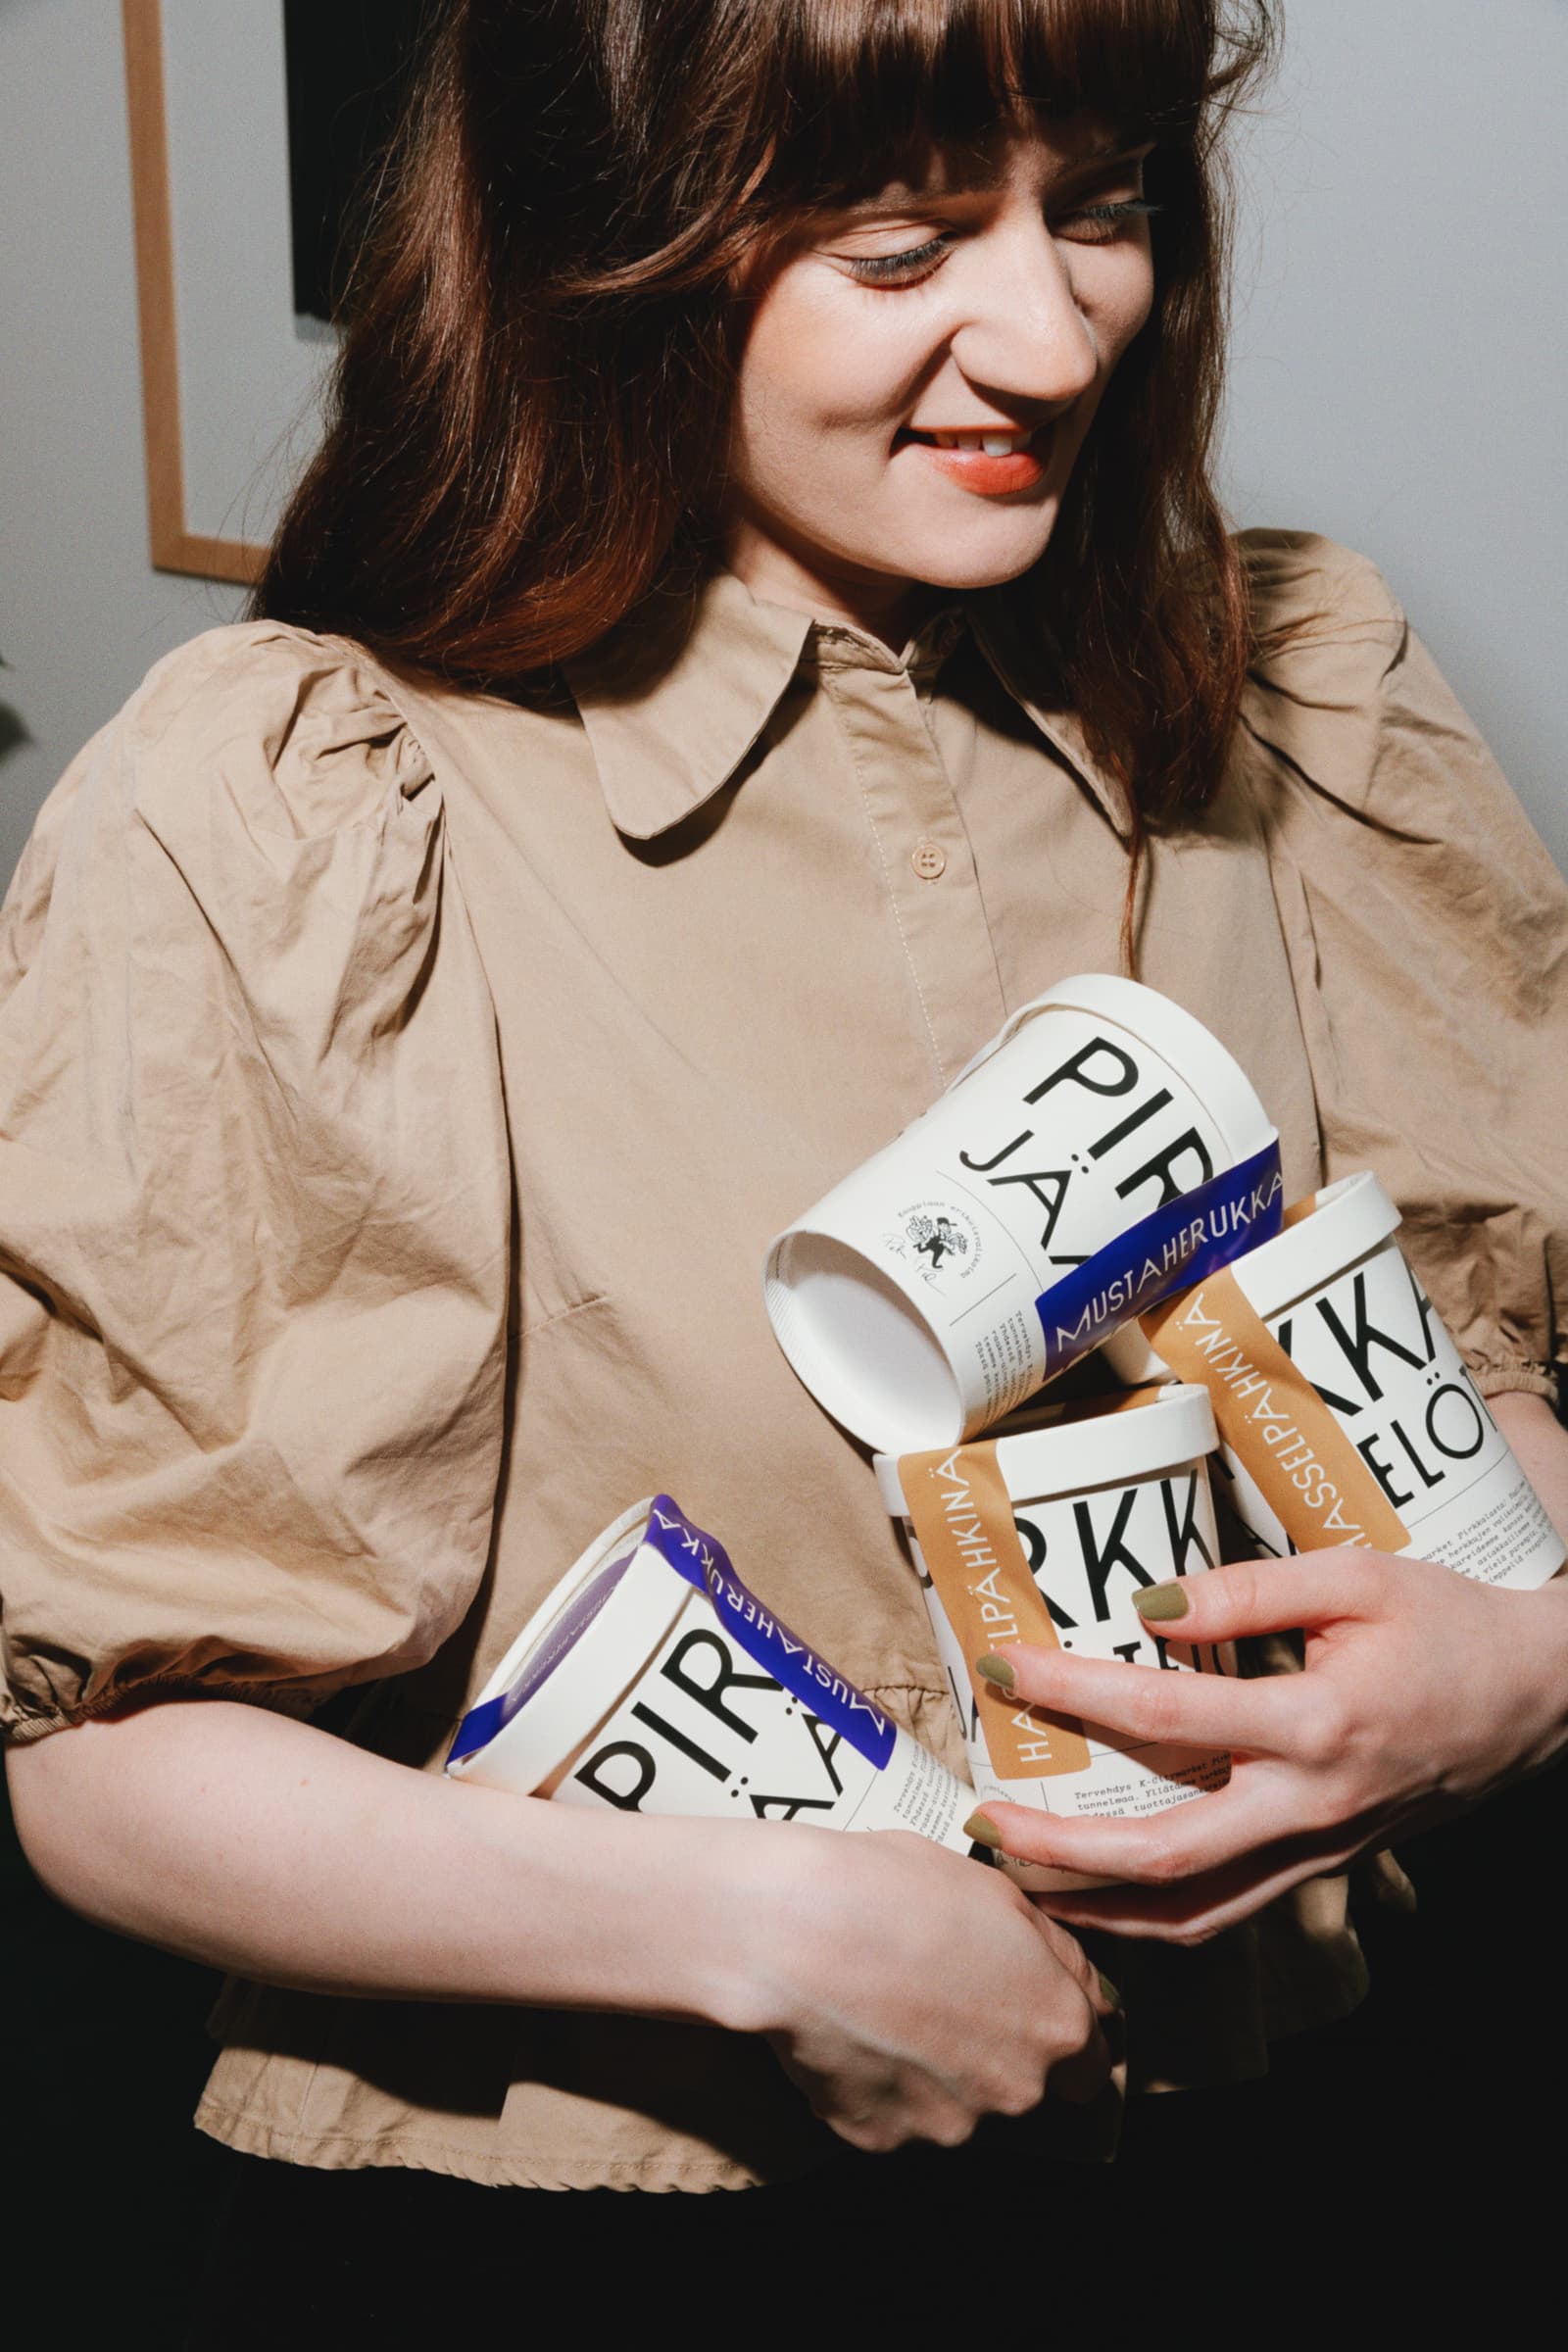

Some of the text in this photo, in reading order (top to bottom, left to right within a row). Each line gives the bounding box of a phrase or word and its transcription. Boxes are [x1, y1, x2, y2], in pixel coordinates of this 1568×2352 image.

[959, 1129, 1092, 1265] JÄ
[1055, 1171, 1283, 1352] MUSTAHERUKKA
[652, 1508, 886, 1737] MUSTAHERUKKA
[928, 1448, 1053, 1764] HALPÄHKINÄ
[1075, 1784, 1131, 1801] Tervehdys
[1078, 1793, 1138, 1812] tunnelmaa.
[1083, 1808, 1124, 1818] dessä
